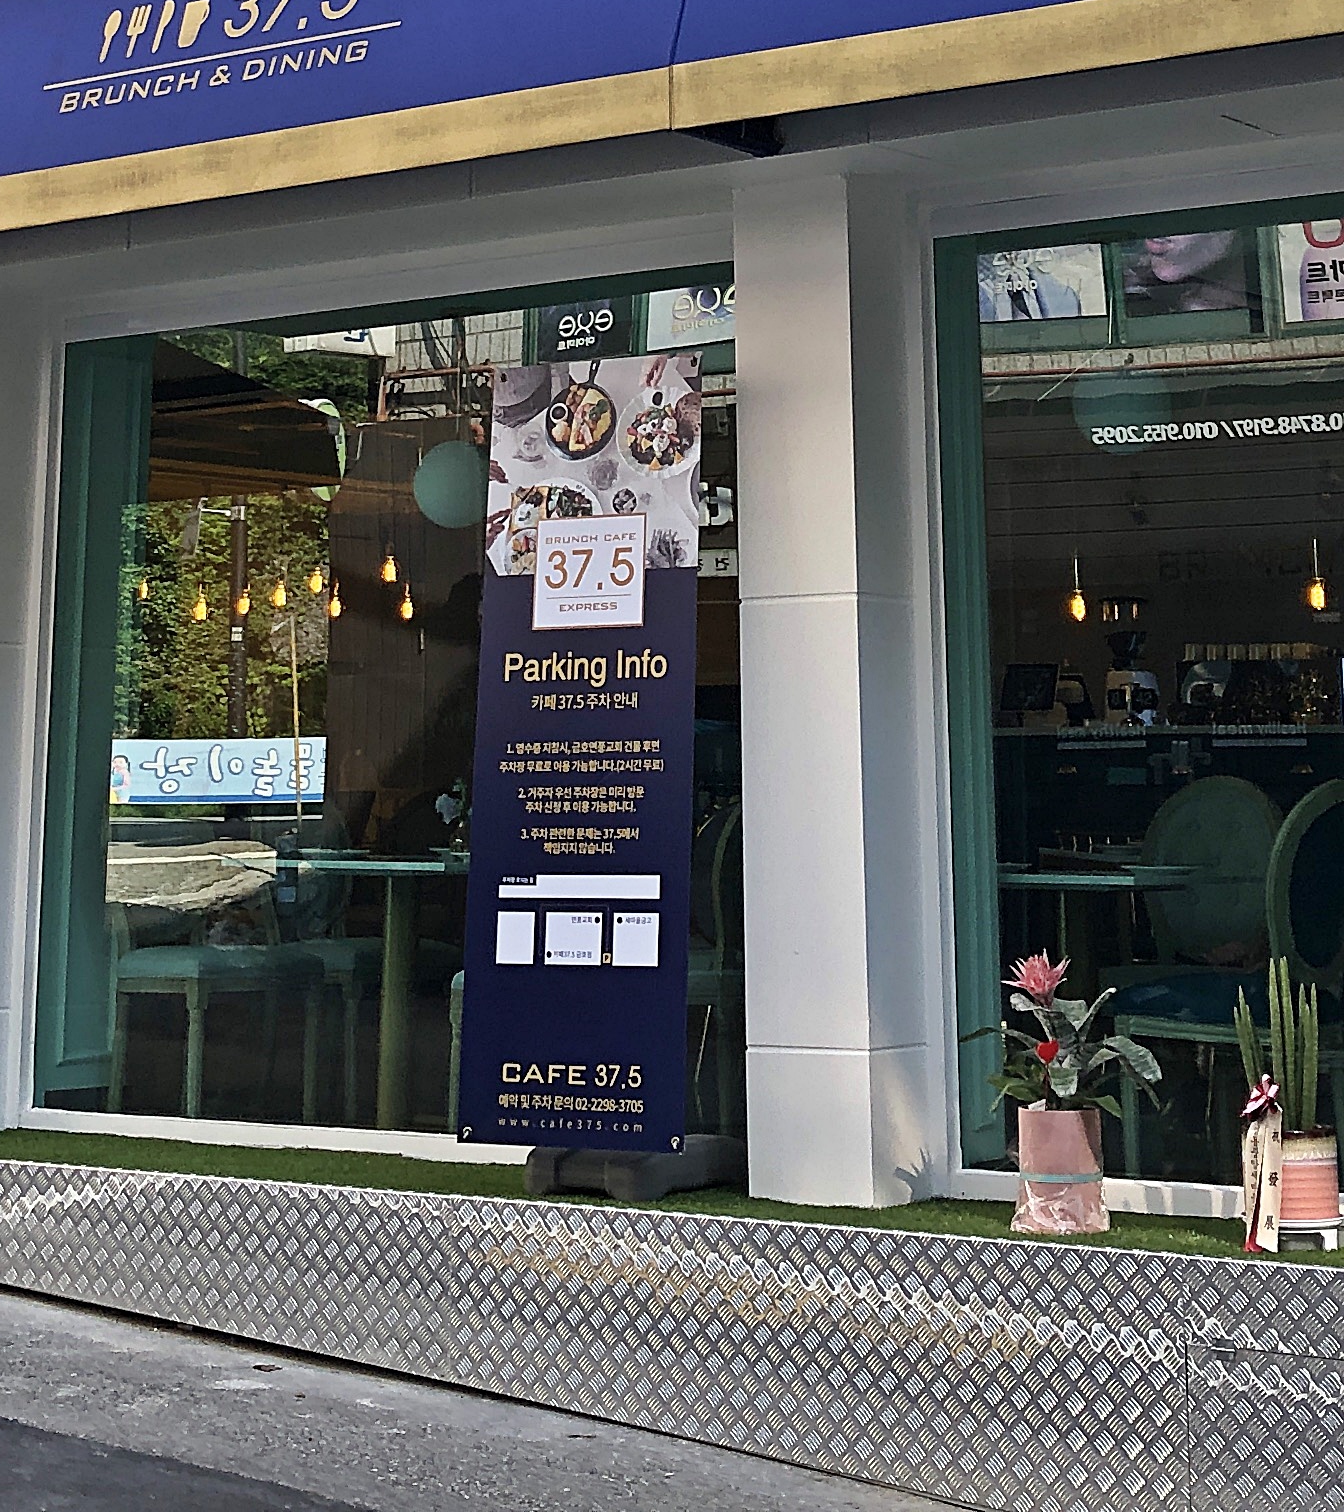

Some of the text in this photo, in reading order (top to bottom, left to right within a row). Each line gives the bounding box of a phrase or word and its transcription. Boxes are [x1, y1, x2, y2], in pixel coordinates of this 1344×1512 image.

[58, 39, 370, 115] BRUNCH & DINING
[544, 532, 637, 545] BRUNCH CAFE
[544, 546, 636, 591] 37.5
[558, 601, 618, 613] EXPRESS
[503, 648, 668, 688] Parking Info
[530, 691, 638, 711] 카페 37.5 주차 안내
[501, 1062, 642, 1089] CAFE 37.5
[498, 1094, 644, 1114] 예약 및 주차 문의 02-2298-3705
